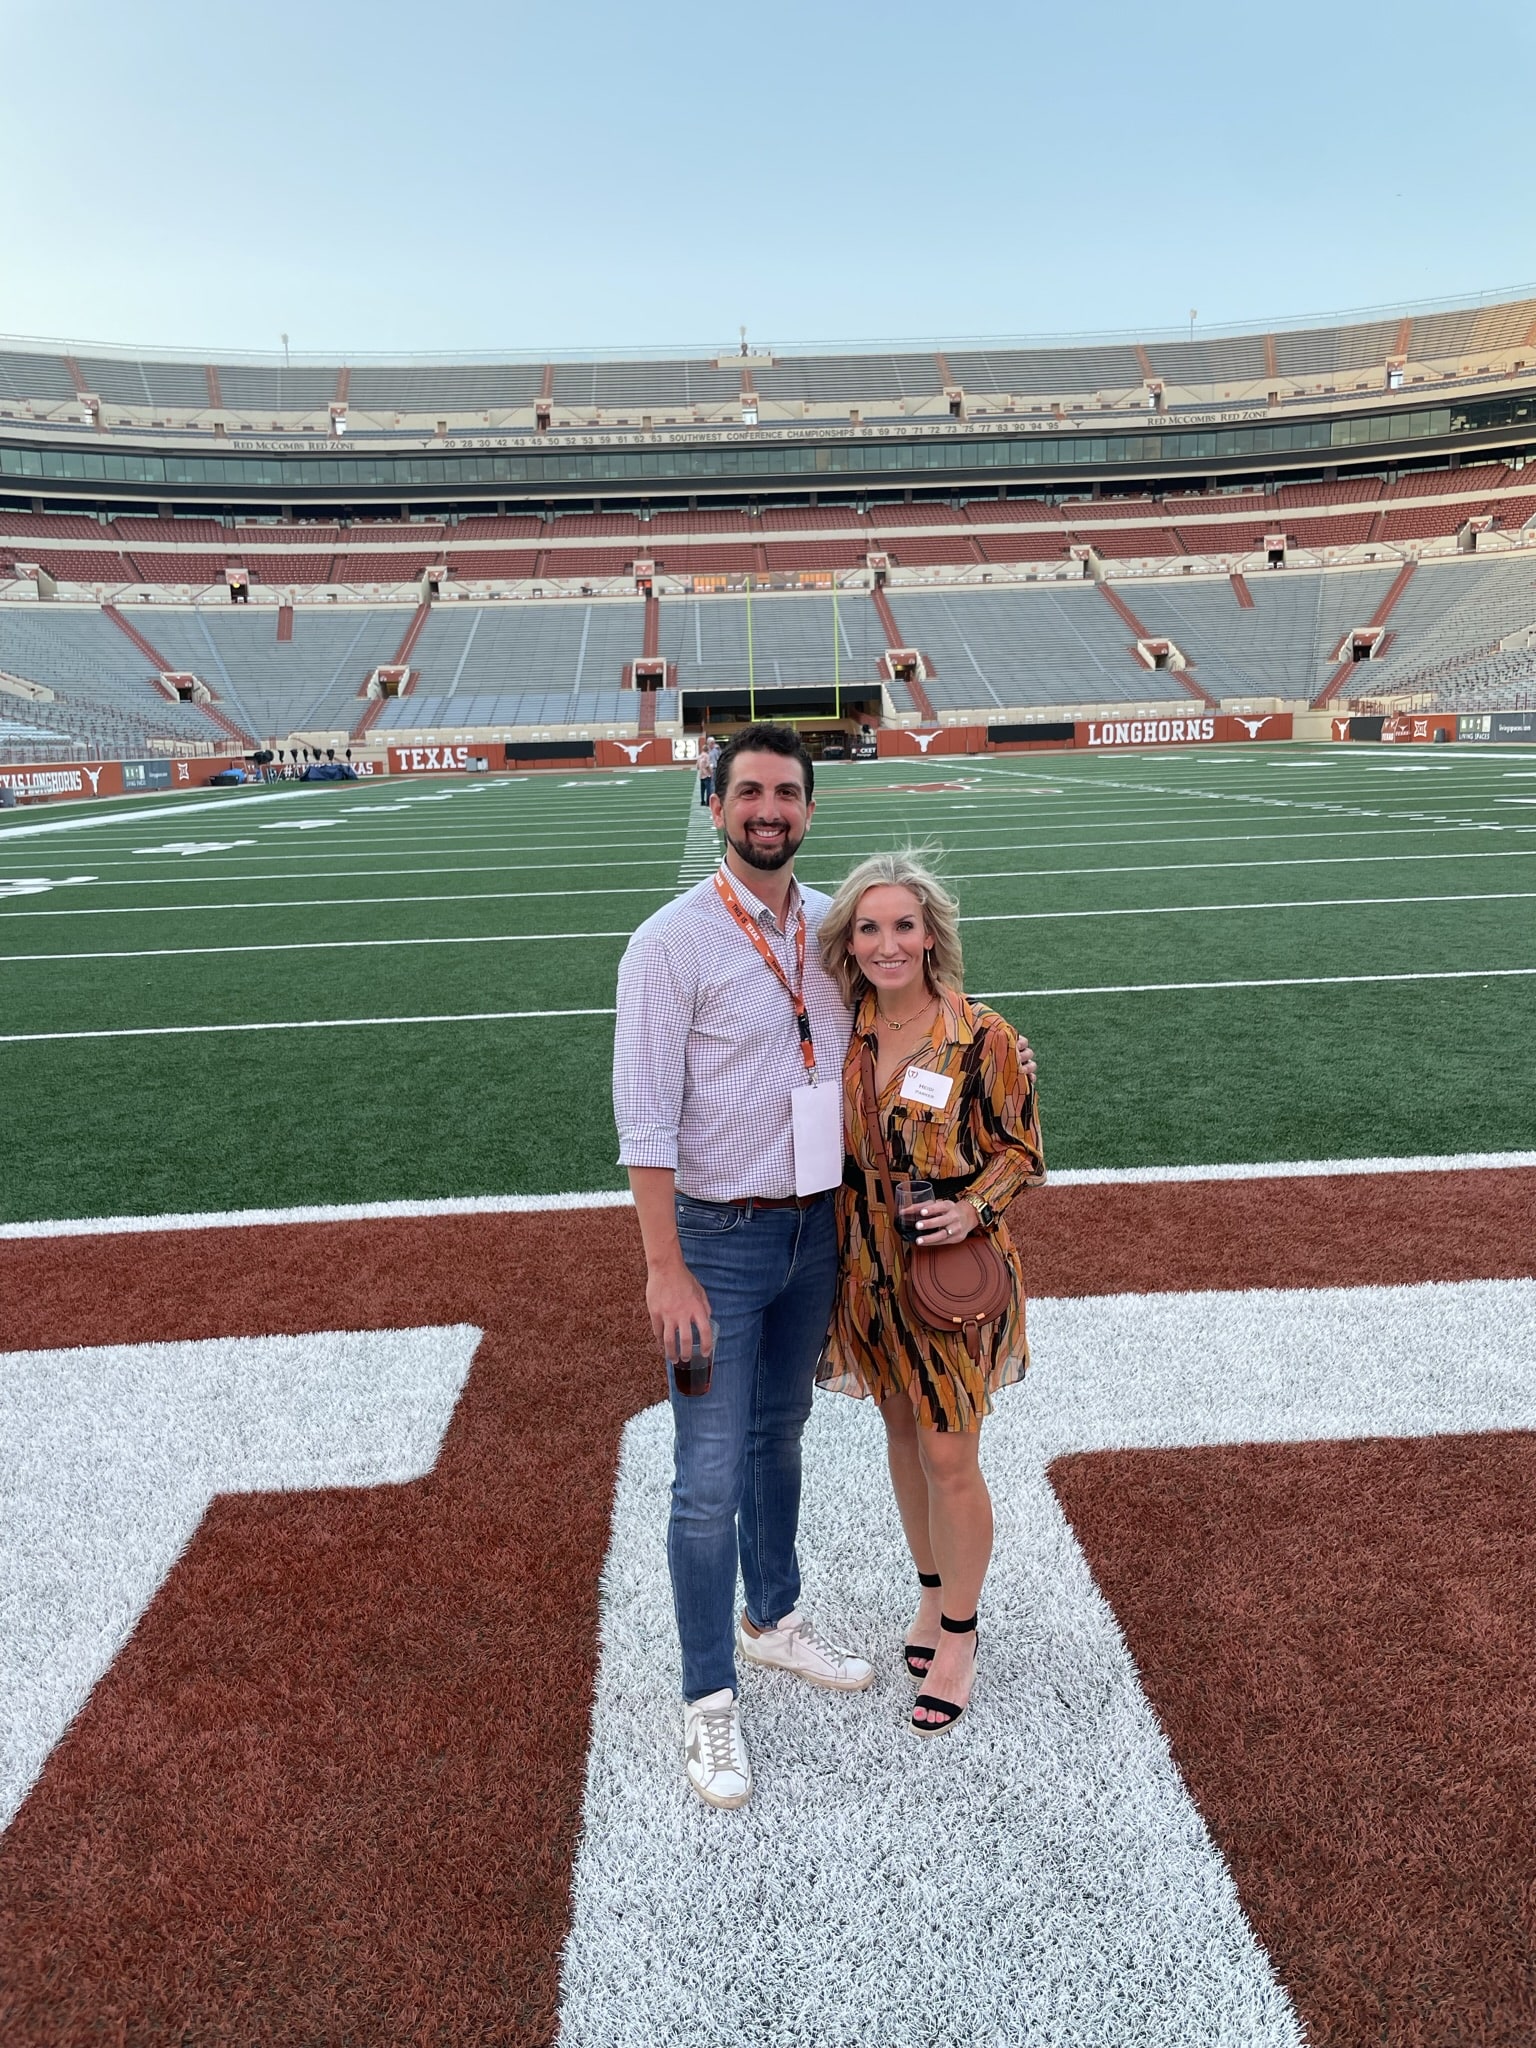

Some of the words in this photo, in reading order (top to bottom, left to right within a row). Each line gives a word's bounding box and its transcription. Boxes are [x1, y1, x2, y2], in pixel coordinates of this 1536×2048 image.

[1148, 418, 1166, 426] RED
[1220, 413, 1240, 421] RED
[1242, 411, 1267, 419] ZONE
[233, 441, 253, 449] RED
[330, 442, 355, 450] ZONE
[670, 433, 722, 442] SOUTHWEST
[727, 431, 782, 440] CONFERENCE
[787, 429, 855, 438] CHAMPIONSHIPS
[1088, 718, 1214, 745] LONGHORNS
[396, 747, 468, 770] TEXAS
[26, 770, 82, 794] LONGHORNS
[732, 904, 743, 918] THIS
[745, 923, 760, 941] TEXAS
